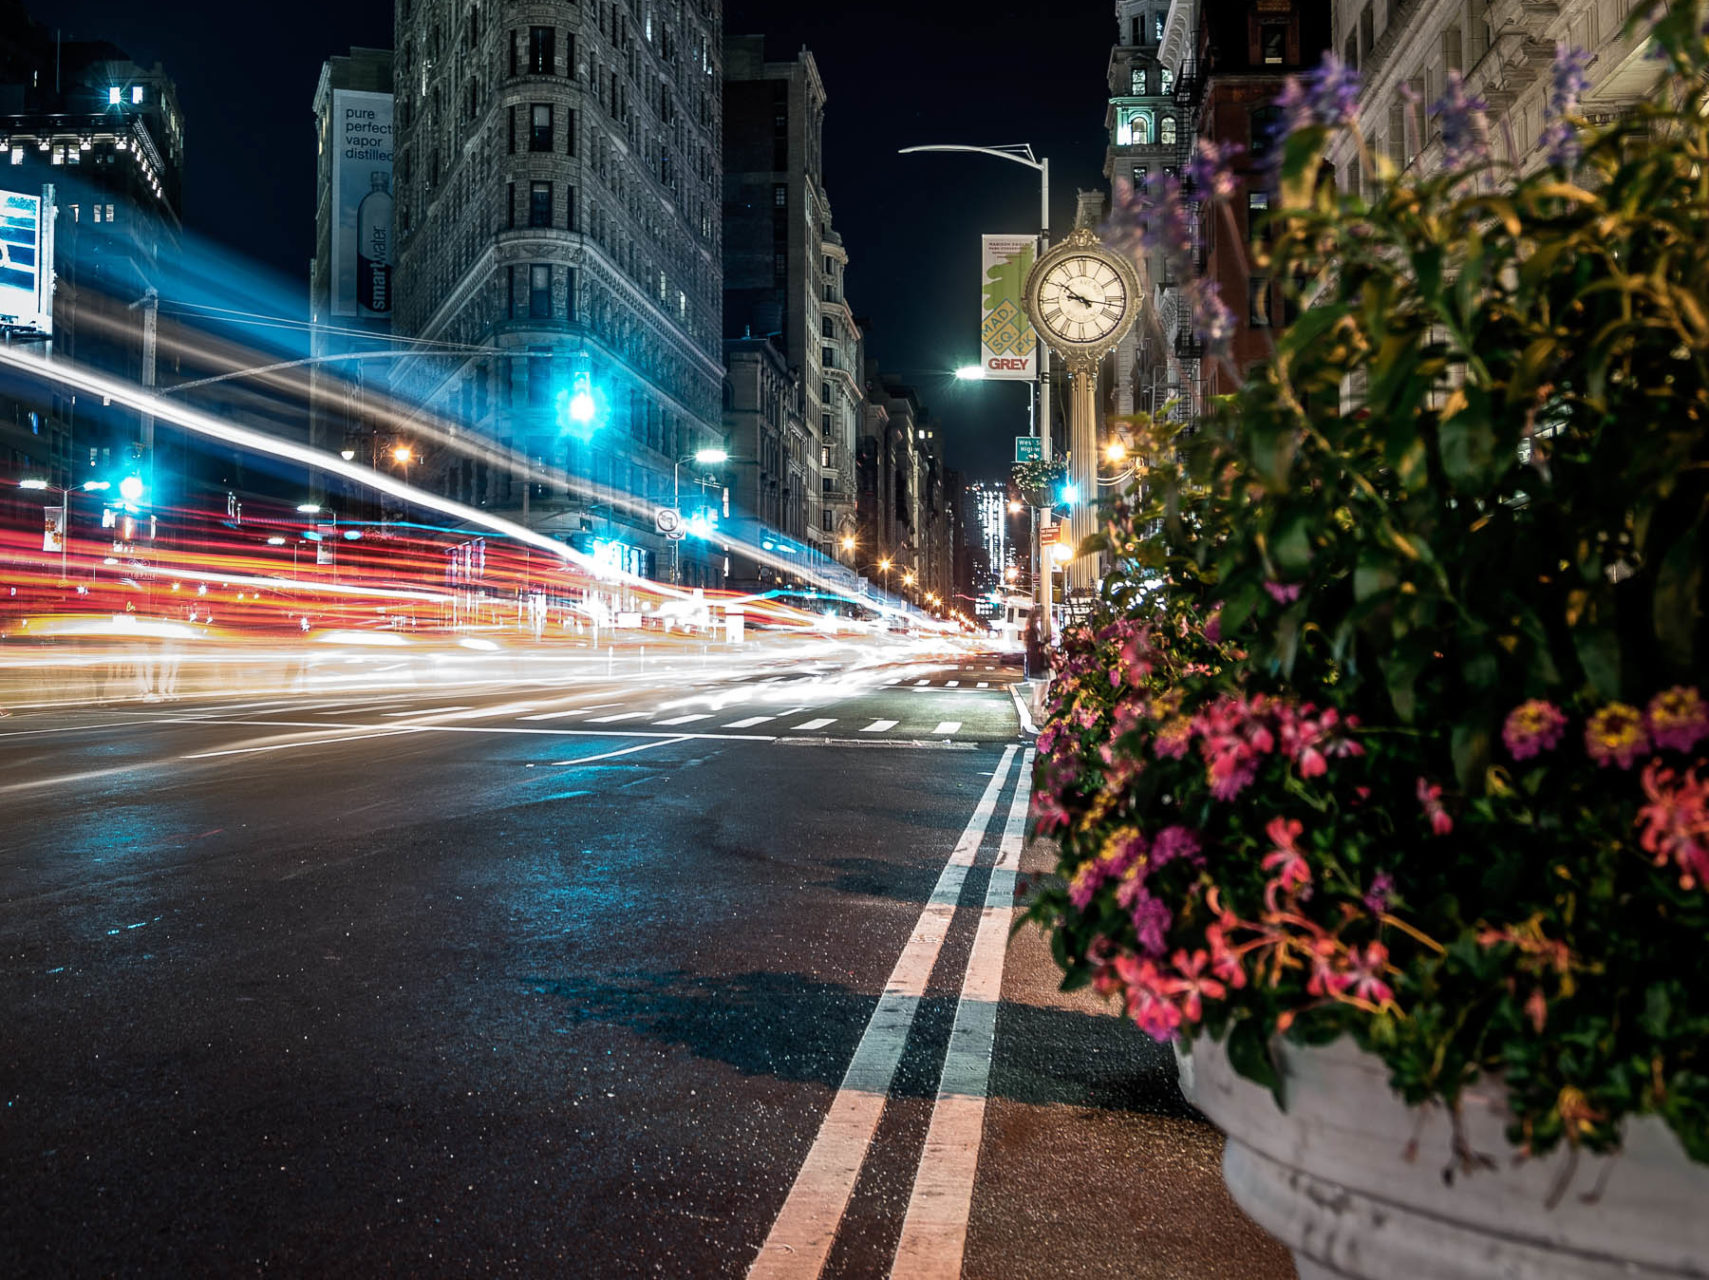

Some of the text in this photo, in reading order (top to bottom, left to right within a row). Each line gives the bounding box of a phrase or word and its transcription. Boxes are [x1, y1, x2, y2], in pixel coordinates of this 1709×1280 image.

[346, 109, 375, 120] pure
[346, 122, 393, 134] perfect
[346, 136, 383, 148] vapor
[370, 226, 386, 310] smartwater
[982, 309, 1014, 337] MAD.
[993, 331, 1017, 350] SQ.
[988, 357, 1029, 371] GREY
